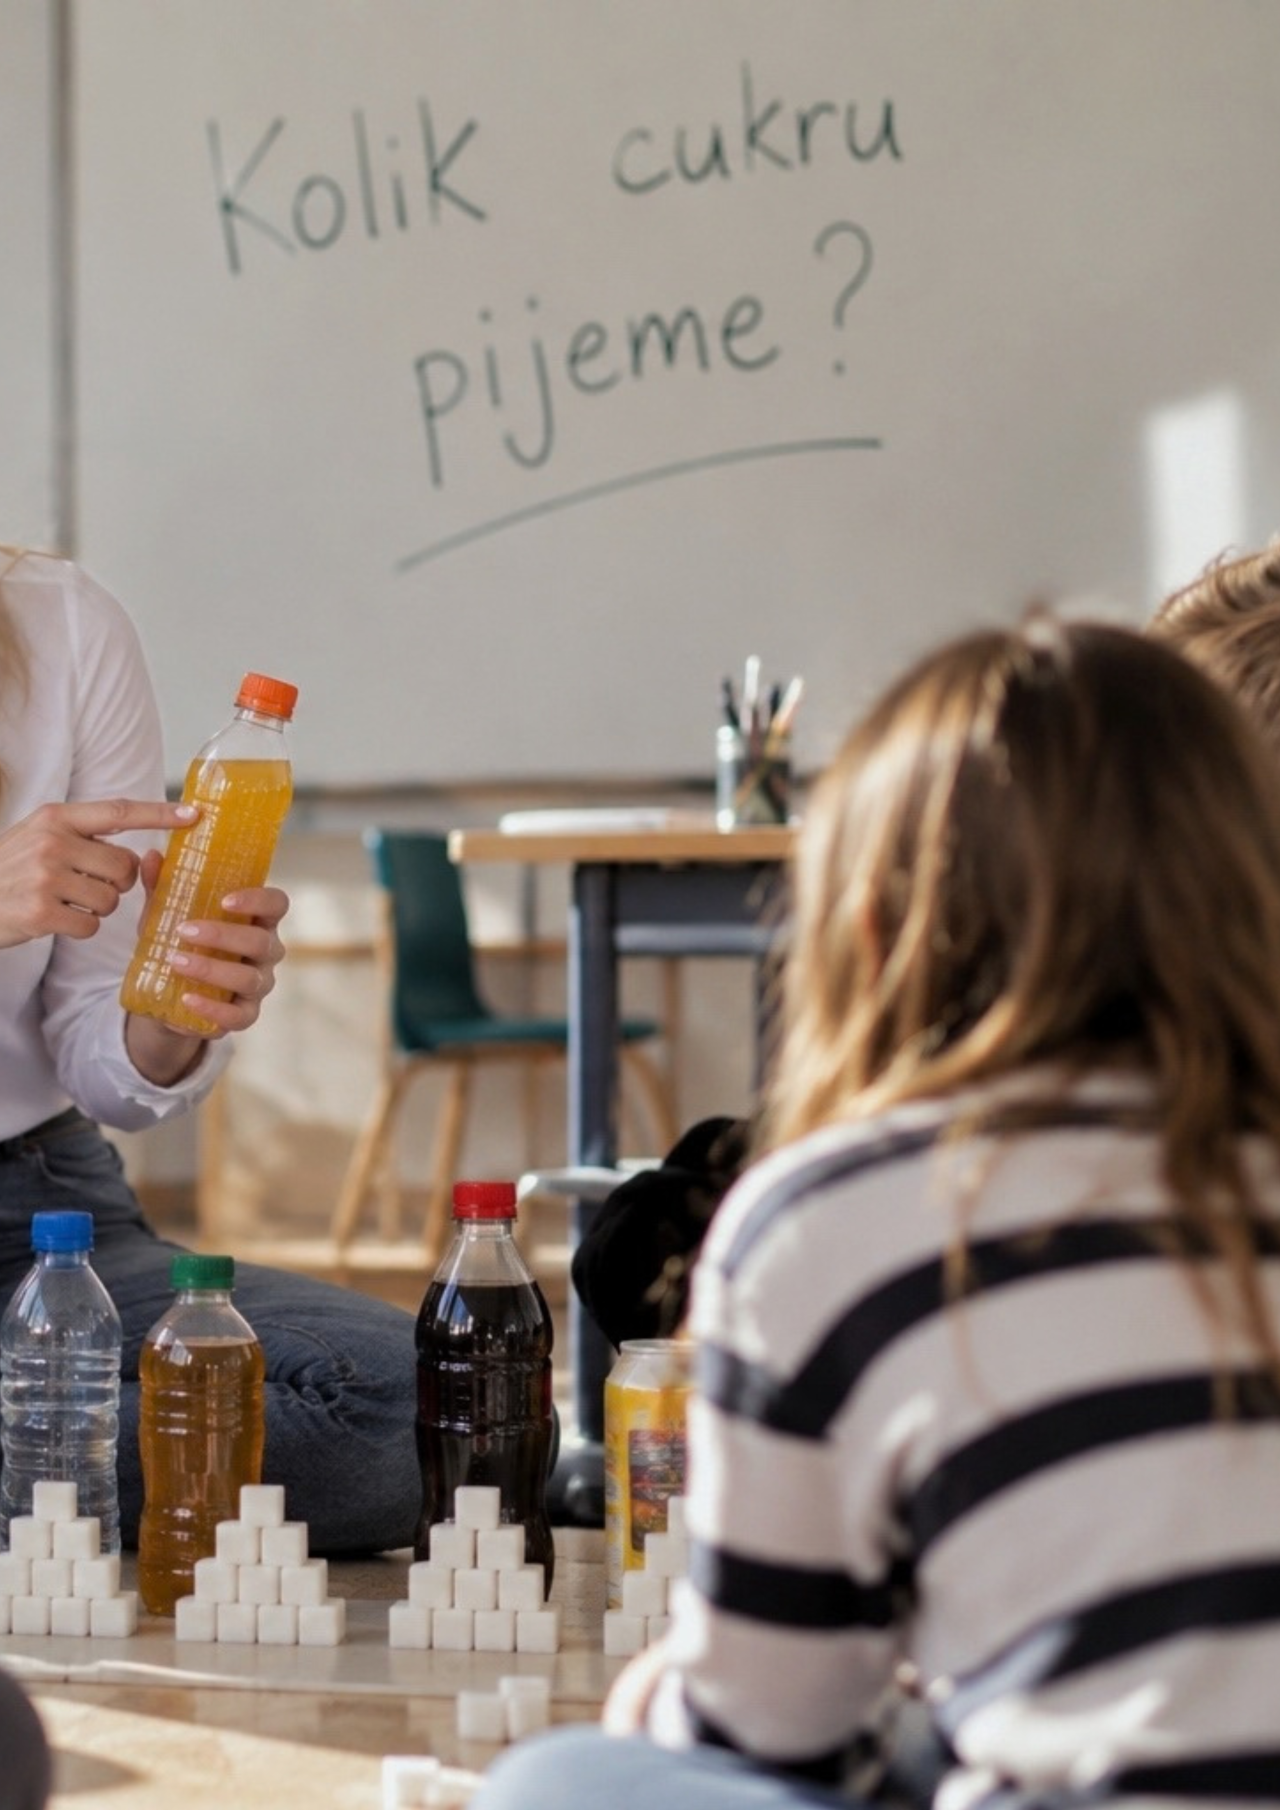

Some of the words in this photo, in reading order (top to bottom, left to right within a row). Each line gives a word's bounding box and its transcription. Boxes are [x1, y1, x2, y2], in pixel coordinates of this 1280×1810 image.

[208, 97, 488, 277] Kolik
[613, 59, 904, 195] cukru
[414, 294, 781, 489] pijeme
